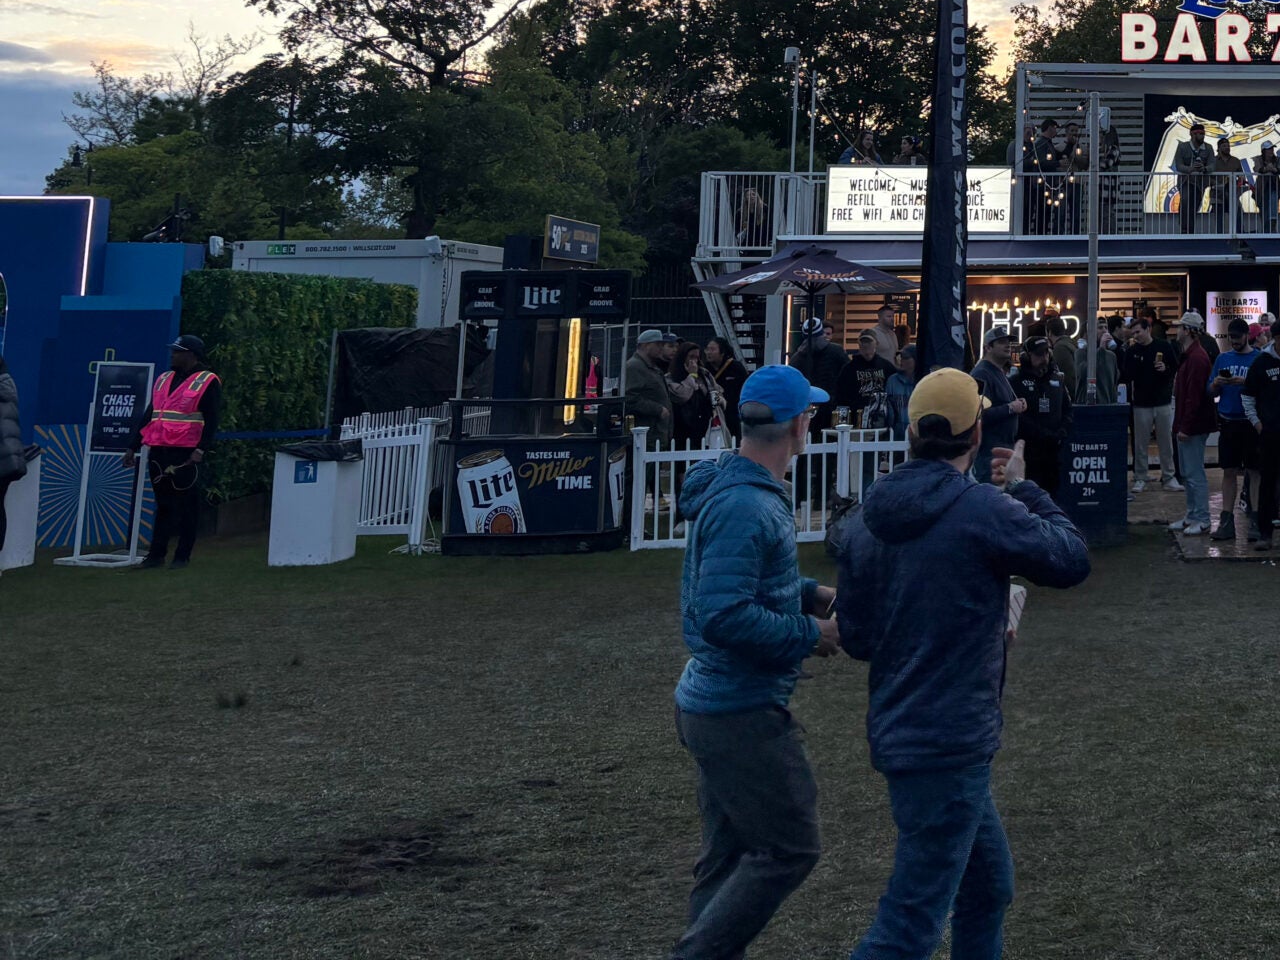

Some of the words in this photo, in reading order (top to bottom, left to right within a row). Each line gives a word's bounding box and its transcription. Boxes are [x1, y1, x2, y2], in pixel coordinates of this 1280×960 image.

[1121, 12, 1253, 63] BAR
[847, 194, 875, 206] REFILL
[891, 194, 927, 206] RECHAR
[832, 209, 853, 221] FREE
[863, 209, 882, 221] WIFI
[891, 209, 909, 221] AND
[969, 209, 1005, 221] TATIONS
[953, 170, 964, 266] FANS
[267, 244, 296, 255] FLEX
[521, 286, 561, 310] Lite
[950, 281, 966, 350] ALL
[1210, 307, 1231, 315] MUSIC
[102, 394, 136, 406] CHASE
[102, 406, 134, 417] LAWN
[526, 451, 553, 459] TASTES
[1072, 456, 1106, 470] OPEN
[518, 455, 596, 490] Miller
[1068, 471, 1085, 484] TO
[1087, 470, 1110, 484] ALL
[467, 471, 513, 508] Lite
[555, 475, 593, 490] TIME
[615, 472, 624, 500] Li
[1082, 487, 1096, 497] 21+
